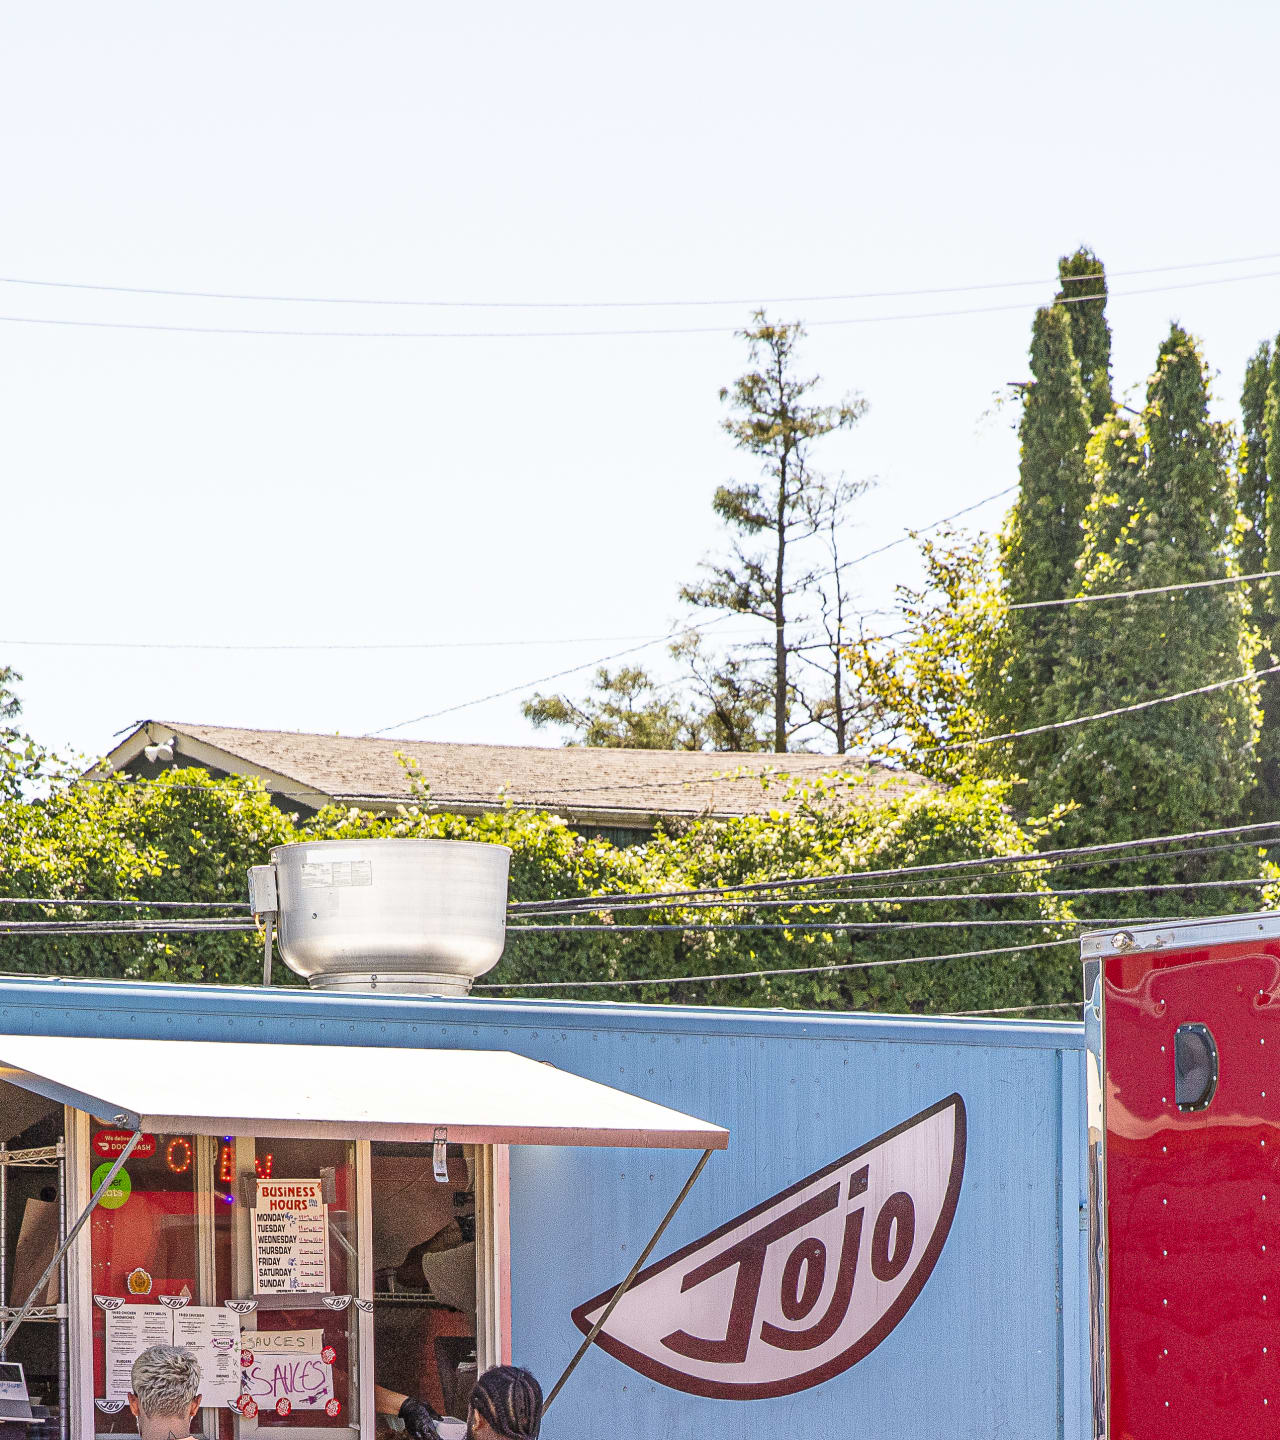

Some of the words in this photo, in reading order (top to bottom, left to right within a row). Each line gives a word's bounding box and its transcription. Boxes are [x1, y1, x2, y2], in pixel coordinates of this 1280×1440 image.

[111, 1143, 151, 1151] DOODASH
[269, 1199, 308, 1211] HOURS
[256, 1213, 285, 1222] MONDAY
[257, 1224, 286, 1233] TUESDAY
[258, 1235, 297, 1244] WEDNESDAY
[258, 1246, 292, 1255] THURSDAY
[258, 1257, 281, 1266] FRIDAY
[660, 1164, 916, 1364] Jojo
[259, 1268, 292, 1277] SATURDAY
[259, 1279, 286, 1288] SUNDAY
